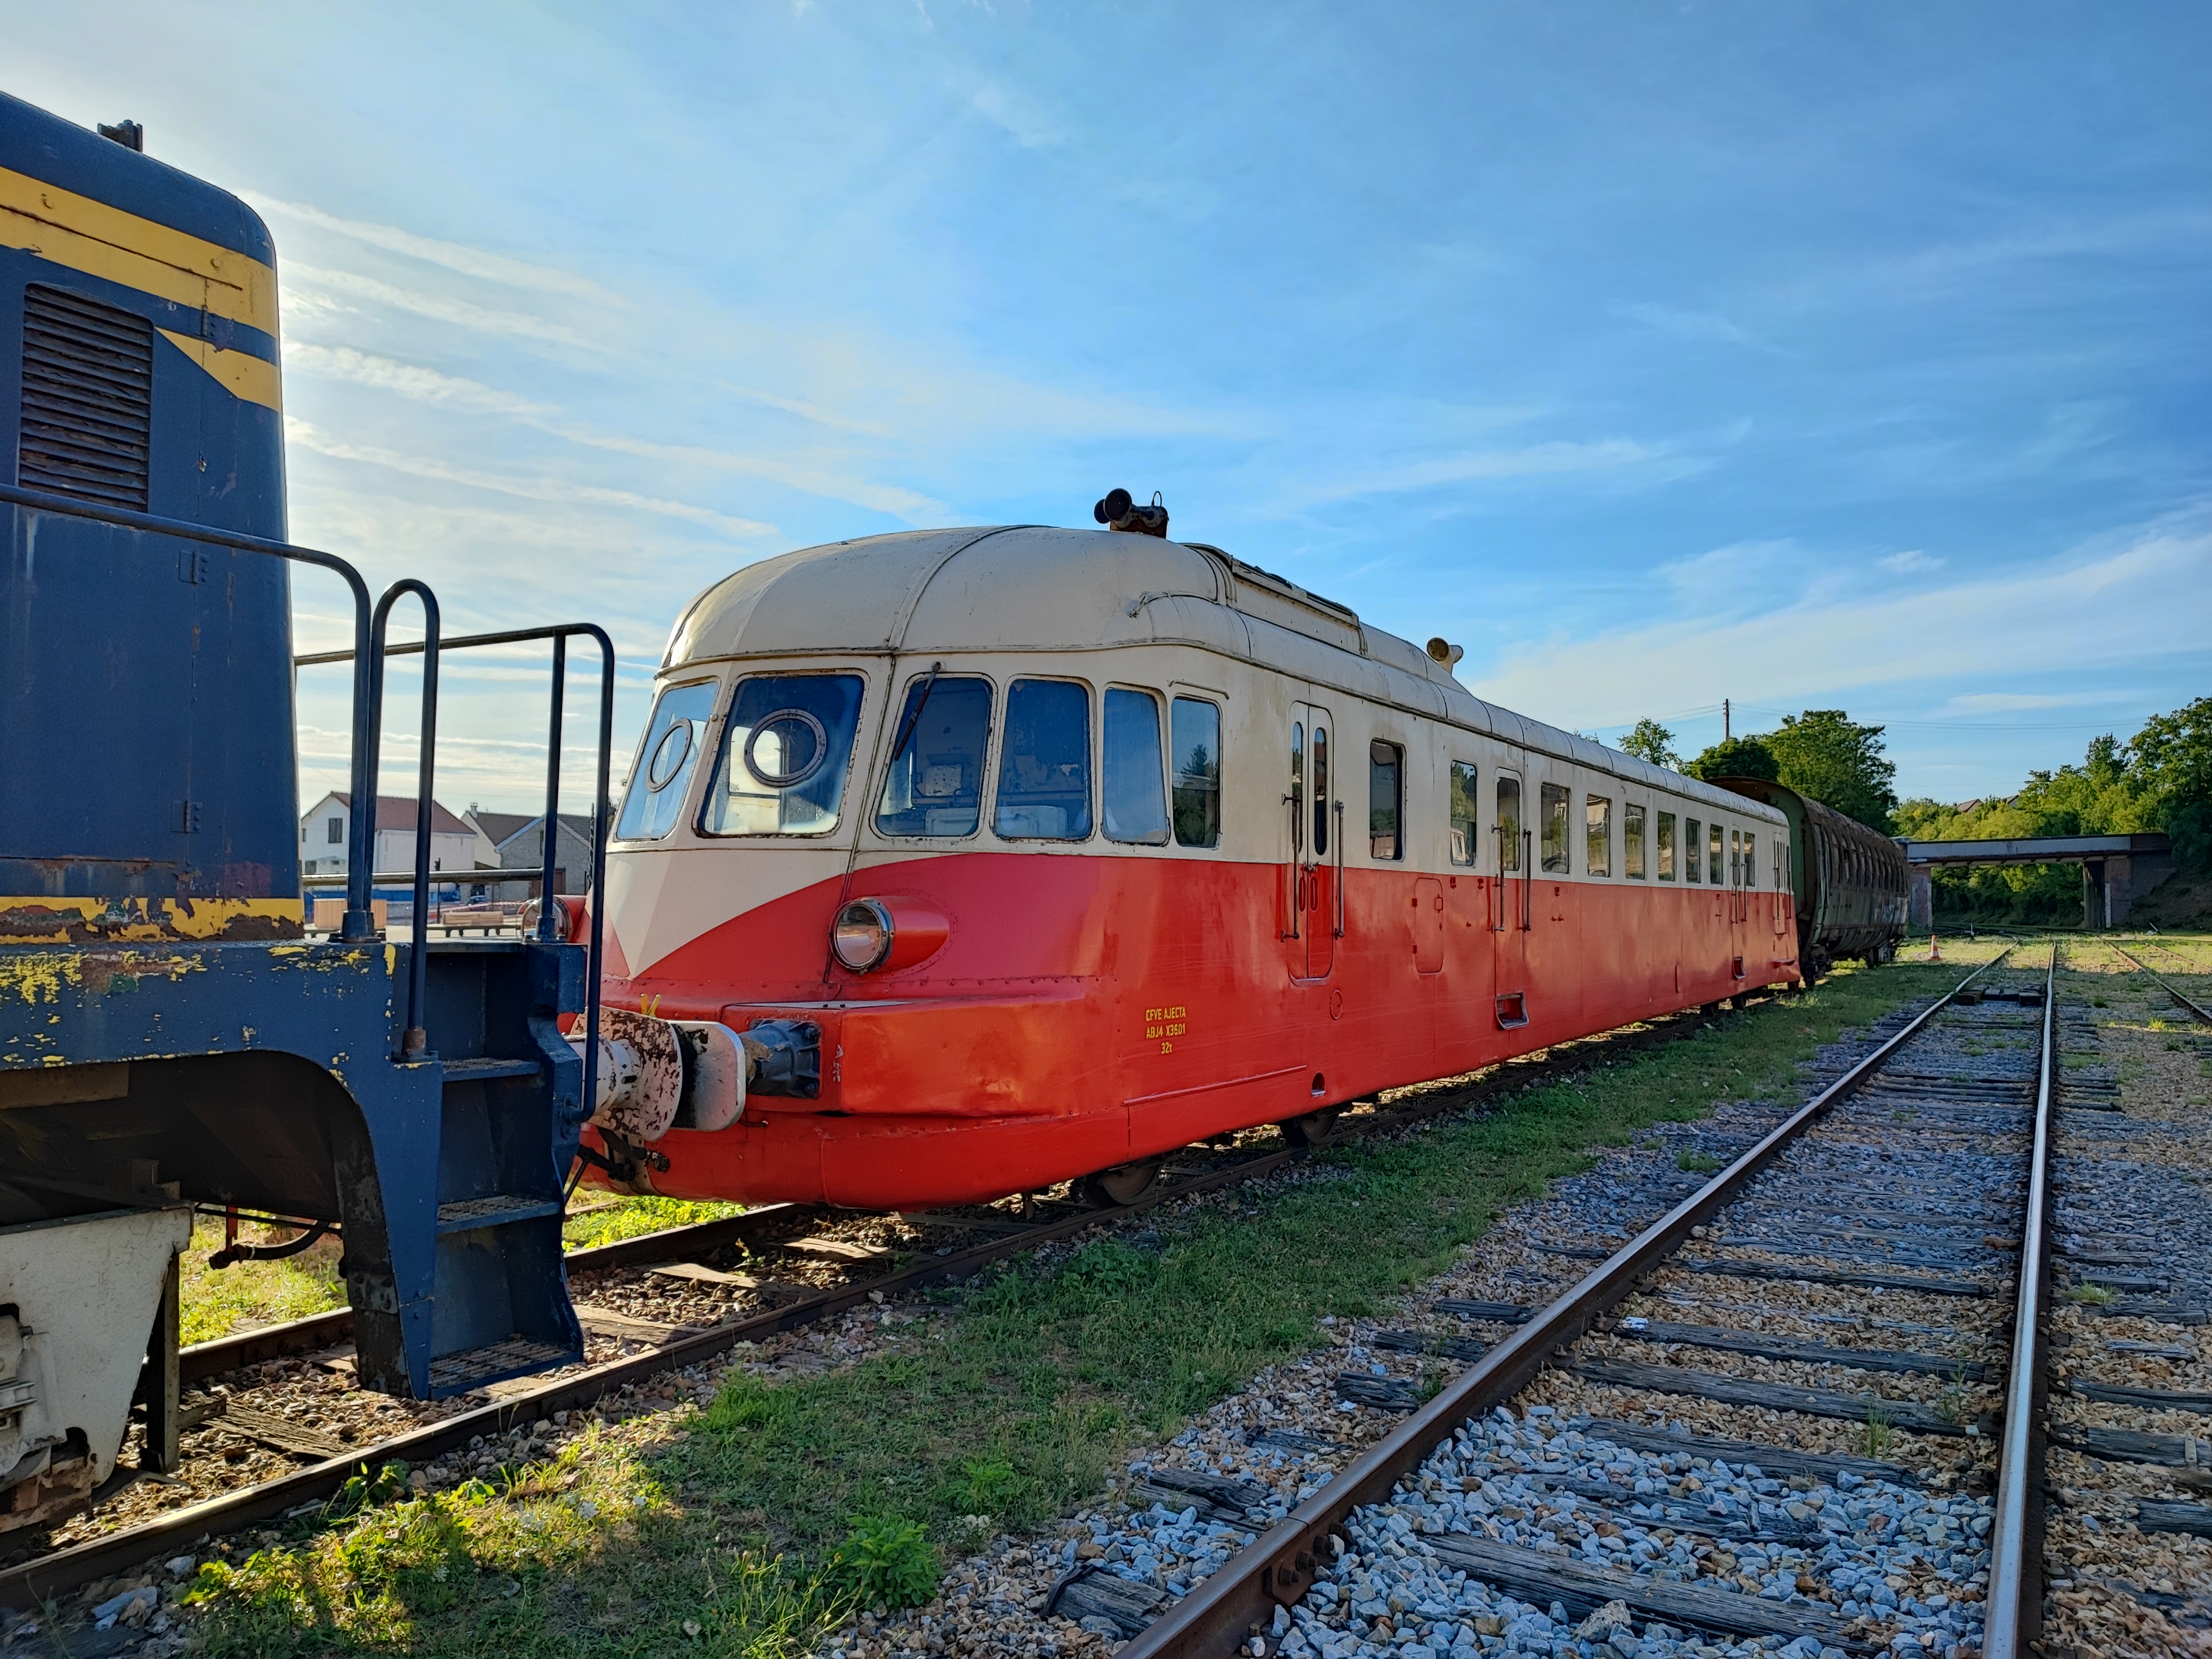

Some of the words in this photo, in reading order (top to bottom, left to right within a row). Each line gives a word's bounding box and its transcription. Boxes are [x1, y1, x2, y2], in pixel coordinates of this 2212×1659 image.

[1146, 1009, 1162, 1021] CFVE
[1164, 1006, 1186, 1019] AJECTA
[1146, 1025, 1163, 1039] ABJ4
[1166, 1023, 1185, 1036] X3601
[1161, 1042, 1172, 1054] 32t
